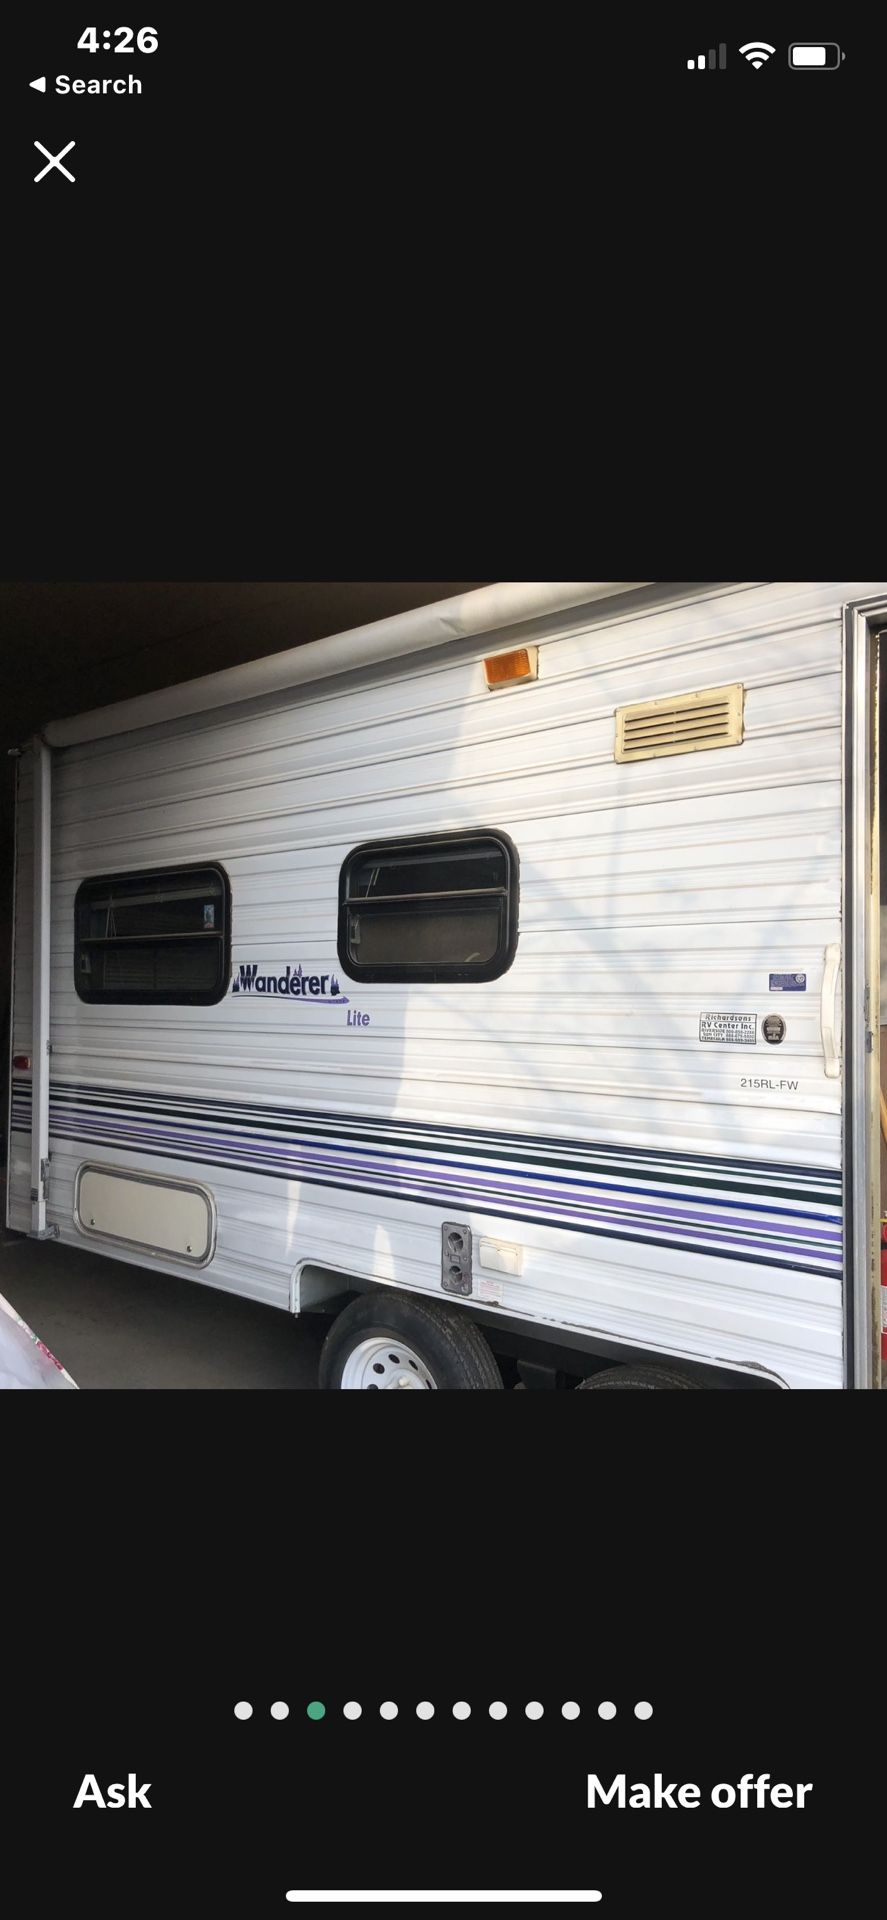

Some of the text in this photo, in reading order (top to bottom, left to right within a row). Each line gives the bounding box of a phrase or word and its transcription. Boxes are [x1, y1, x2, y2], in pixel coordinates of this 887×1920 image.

[239, 964, 330, 996] Wanderer
[346, 1009, 370, 1026] Lite
[740, 1078, 799, 1090] 215RL-FW
